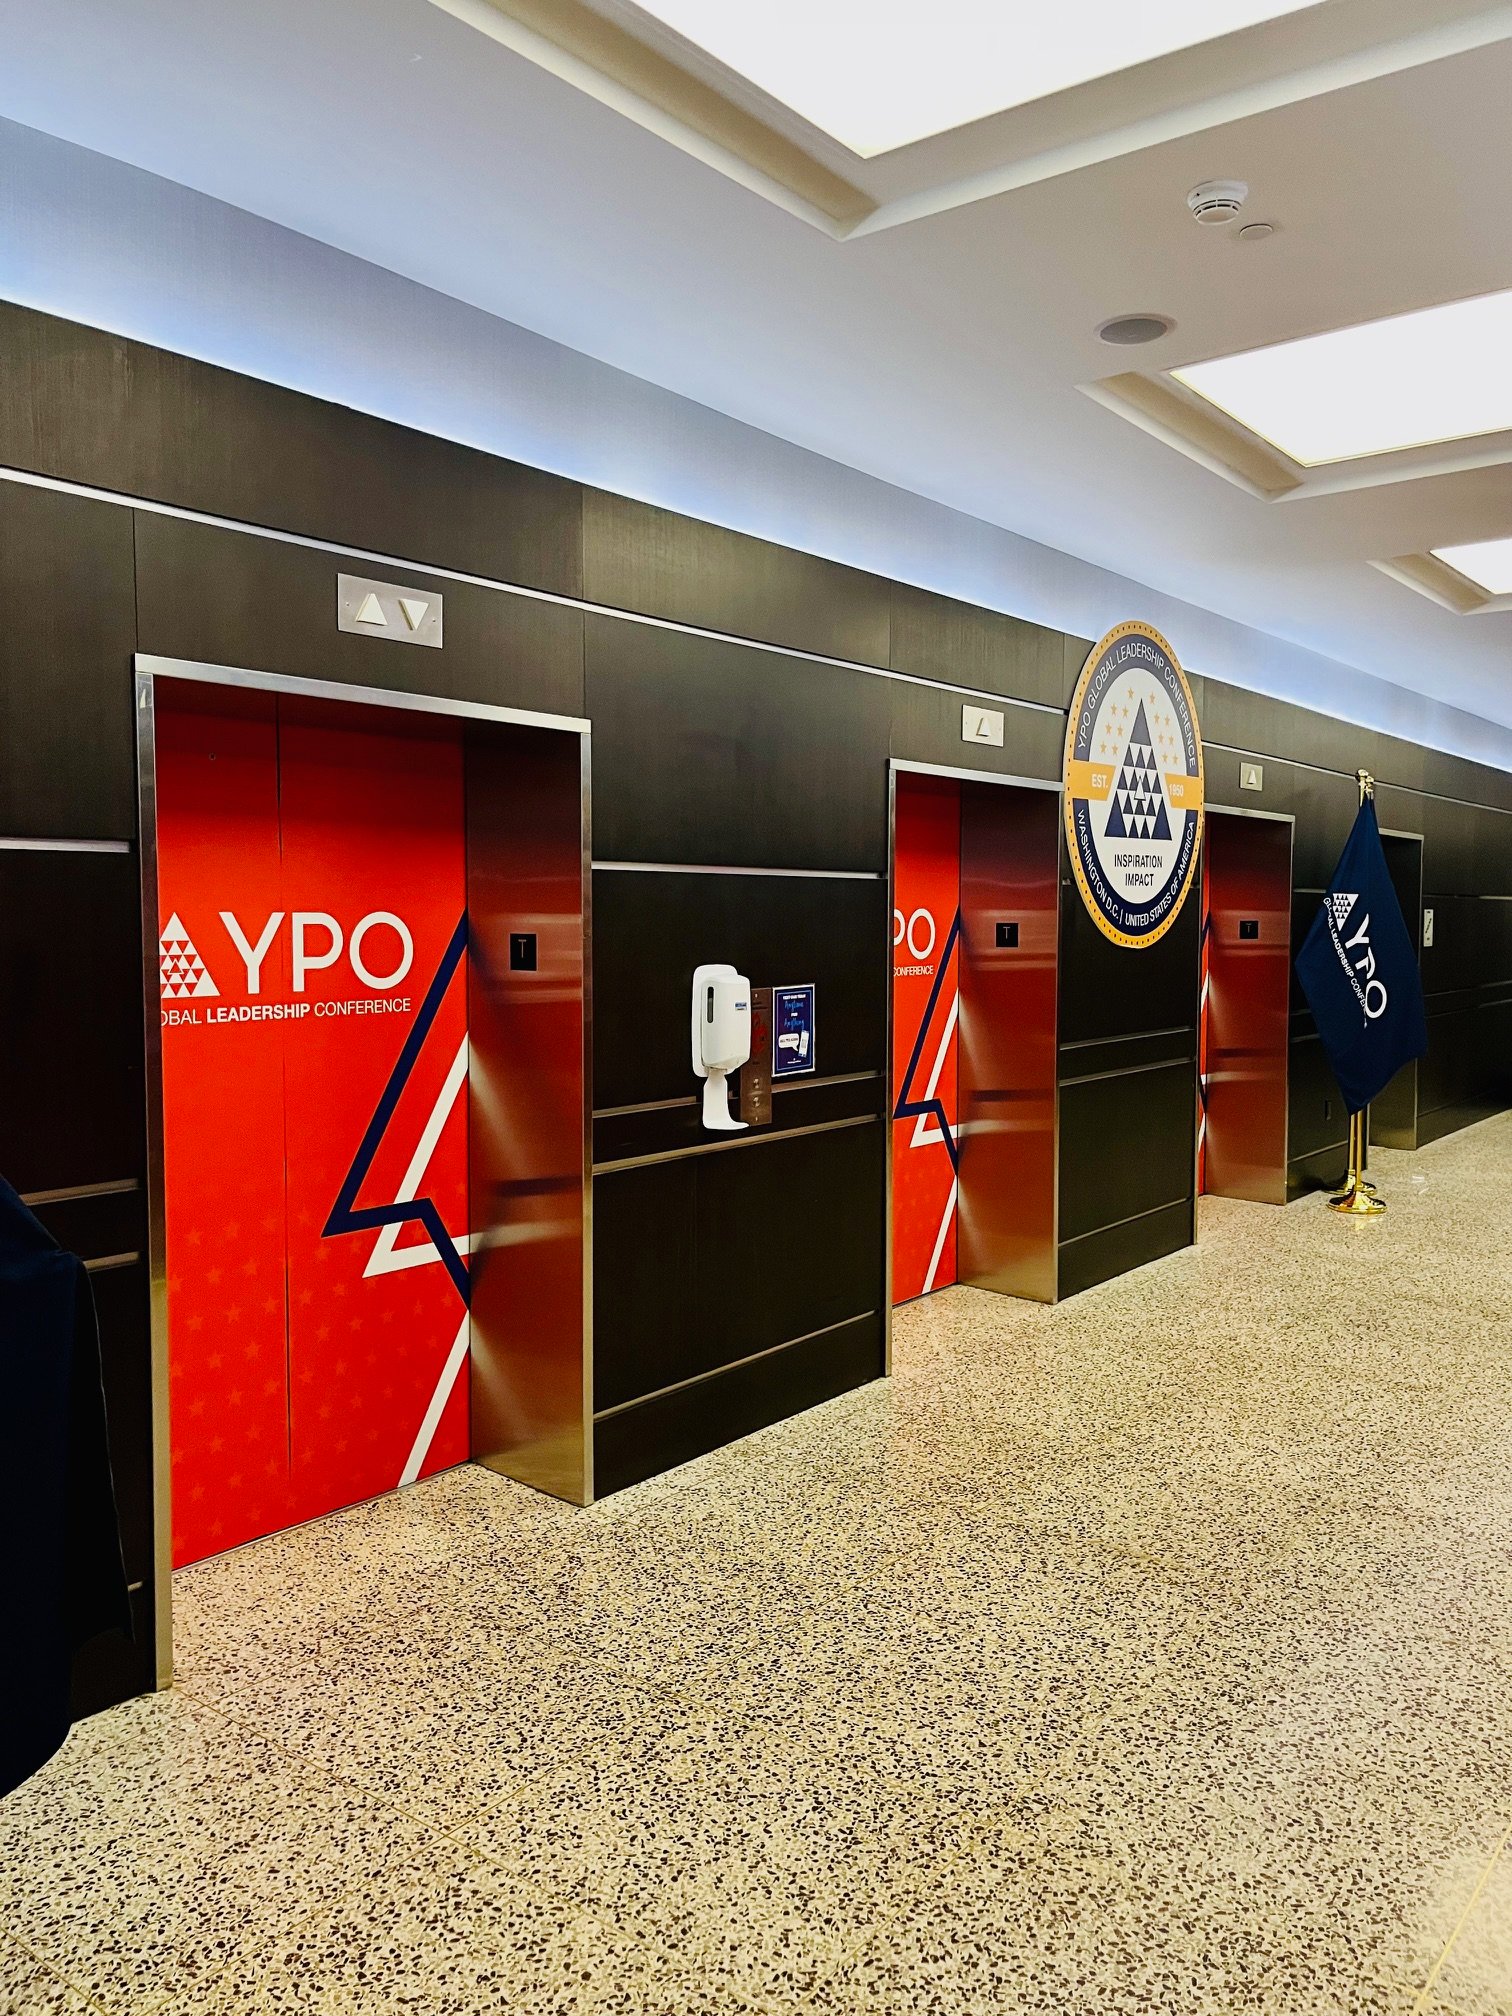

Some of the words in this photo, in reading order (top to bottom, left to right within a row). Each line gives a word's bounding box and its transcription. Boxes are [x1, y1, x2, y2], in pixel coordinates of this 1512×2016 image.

[1078, 711, 1091, 748] YPO
[1087, 656, 1117, 709] GLOBAL
[1116, 643, 1164, 669] LEADERSHIP
[1164, 666, 1196, 768] CONFERENCE
[1091, 773, 1109, 789] EST.
[1077, 809, 1108, 903] WASHINGTON
[1105, 896, 1119, 920] D.C.
[1124, 911, 1149, 926] UNITED
[1149, 892, 1172, 922] STATES
[1170, 876, 1181, 896] OF
[1177, 821, 1195, 881] AMERICA
[1114, 853, 1163, 869] INSPIRATION
[1125, 873, 1154, 887] IMPACT
[1002, 926, 1011, 940] T
[218, 911, 414, 994] YPO
[518, 938, 527, 959] T
[1330, 928, 1355, 978] LEADERSHIP
[160, 1008, 203, 1027] OBAL
[206, 1003, 311, 1023] LEADERSHIP
[314, 998, 412, 1017] CONFERENCE
